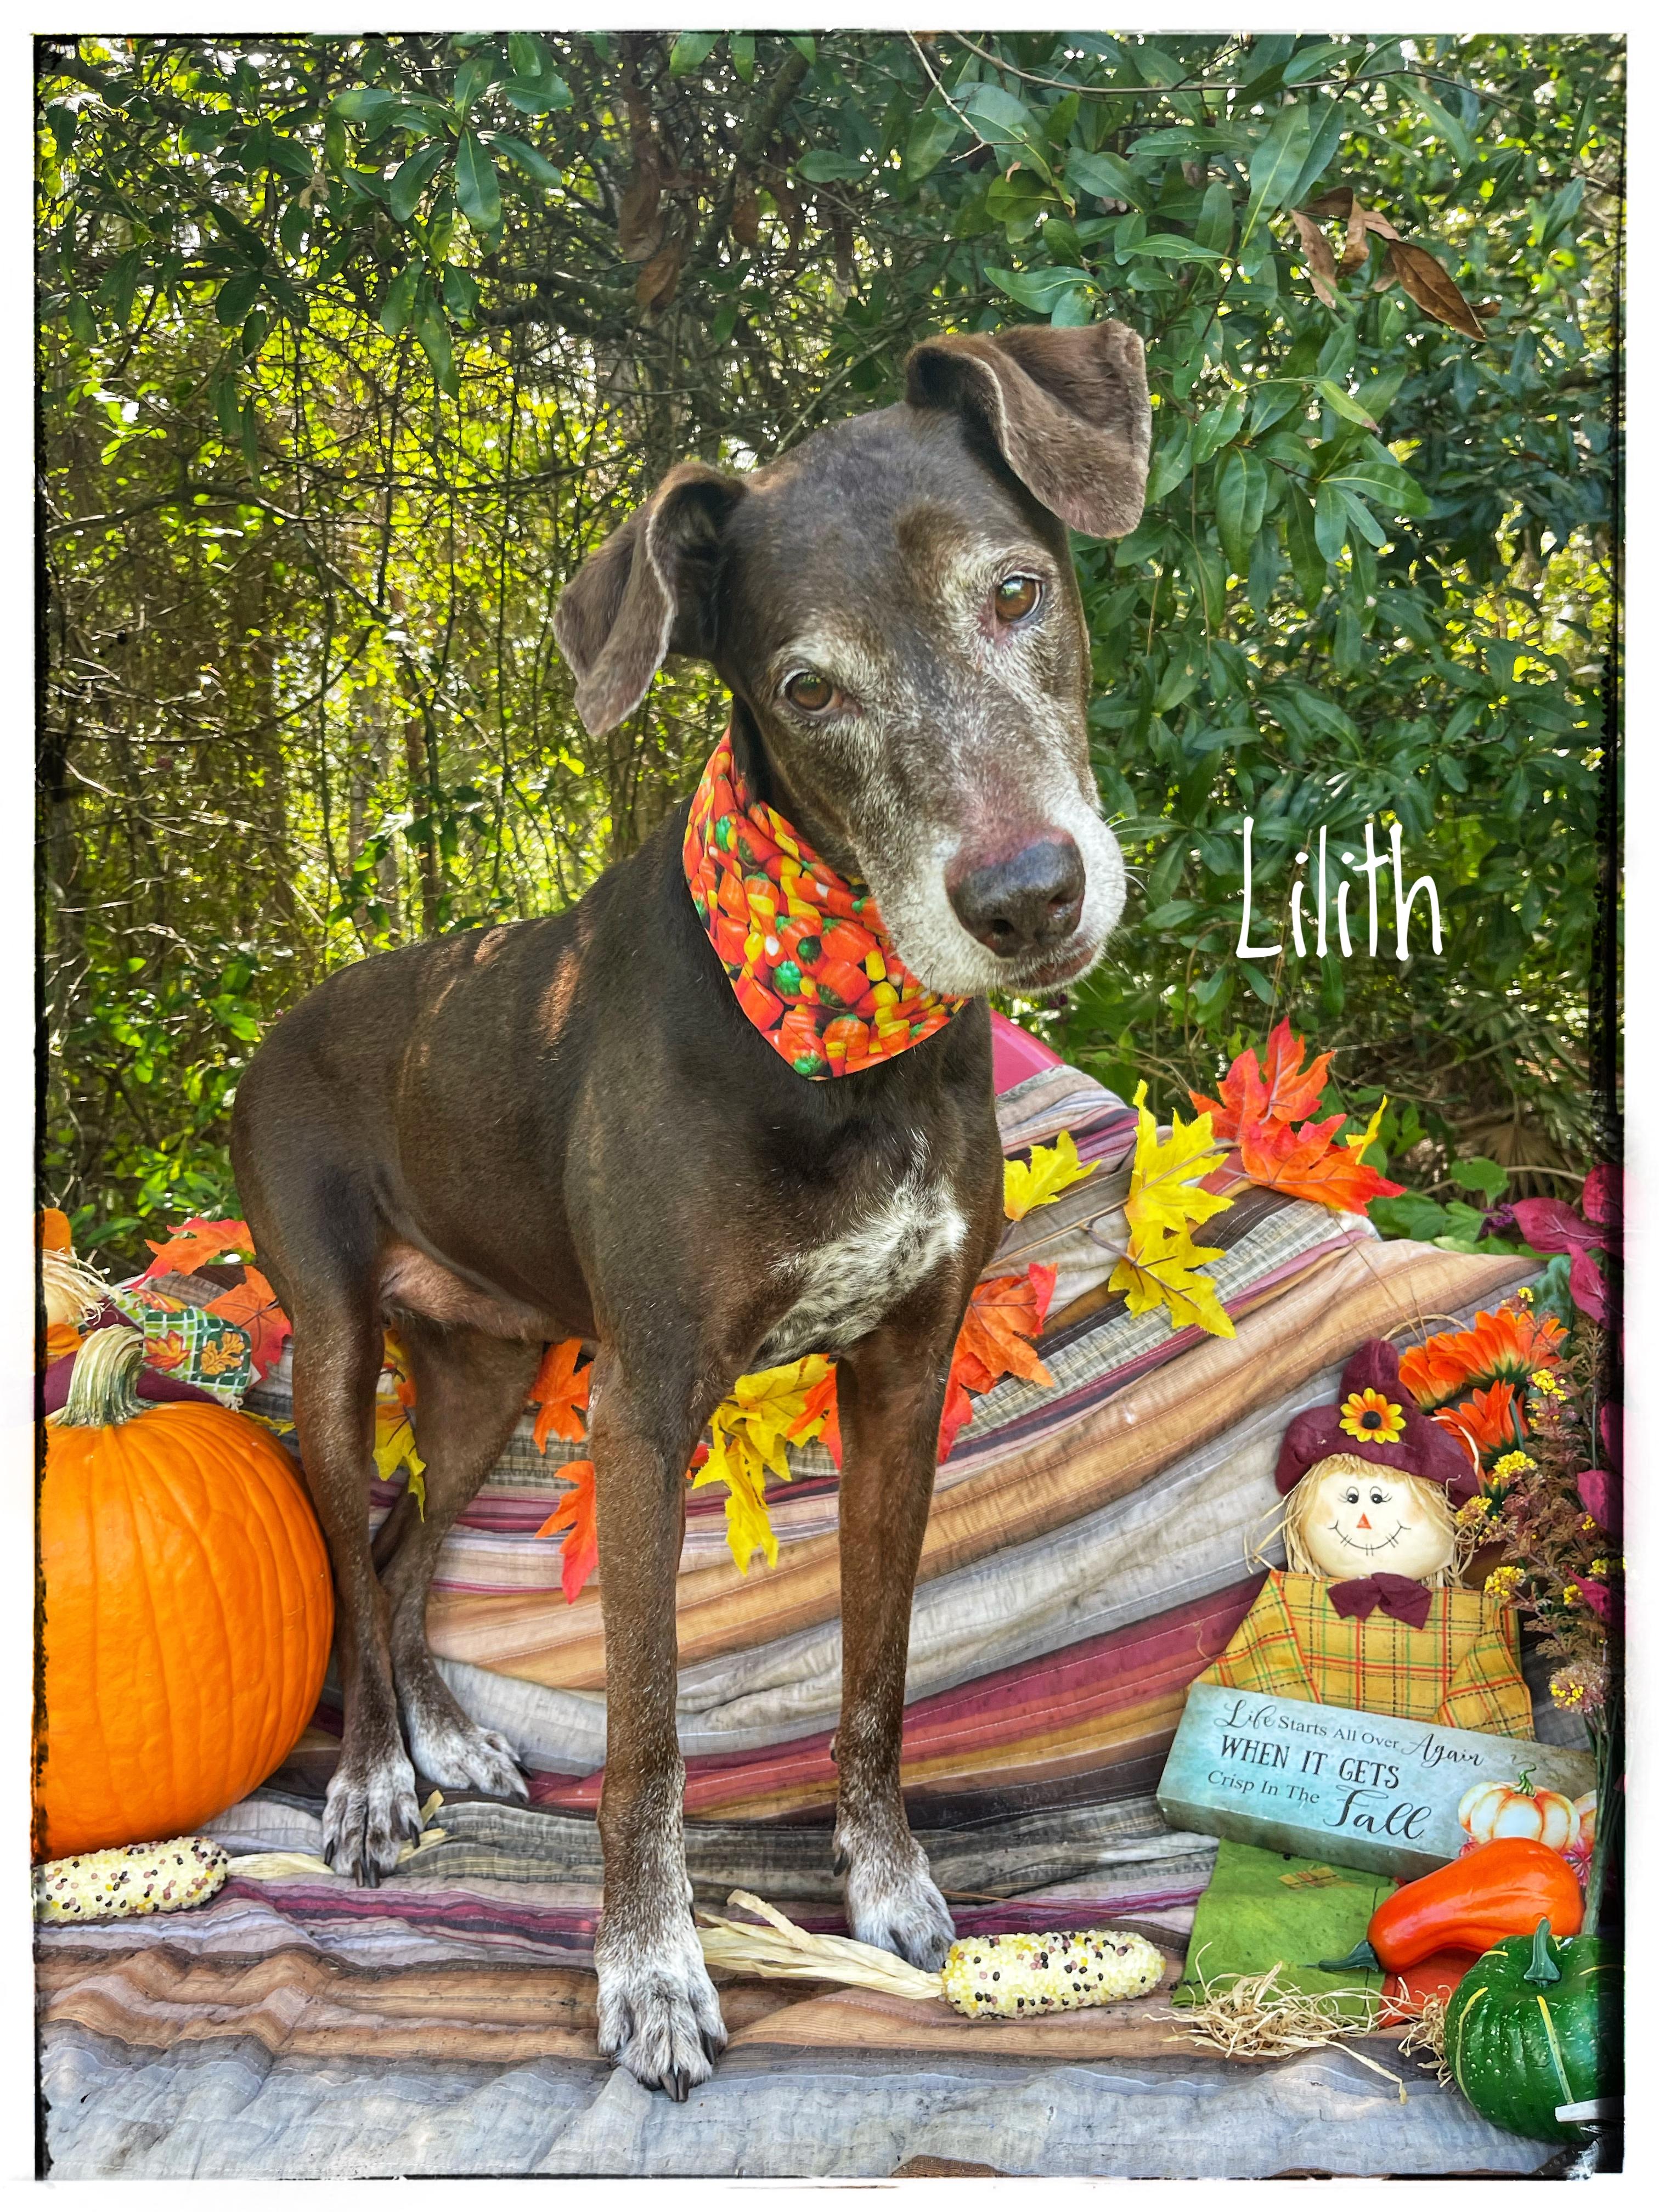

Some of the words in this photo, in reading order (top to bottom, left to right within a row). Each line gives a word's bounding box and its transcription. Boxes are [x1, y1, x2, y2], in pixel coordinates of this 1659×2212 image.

[1213, 1699, 1275, 1729] Life
[1277, 1715, 1328, 1737] Starts
[1333, 1727, 1357, 1742] All
[1361, 1732, 1400, 1750] Over
[1400, 1733, 1485, 1769] Again
[1220, 1734, 1290, 1770] WHEN
[1299, 1750, 1328, 1776] IT
[1339, 1758, 1400, 1790] GETS
[1207, 1769, 1255, 1794] Crisp
[1261, 1779, 1279, 1797] In
[1285, 1784, 1321, 1805] The
[1323, 1783, 1433, 1840] Fall
